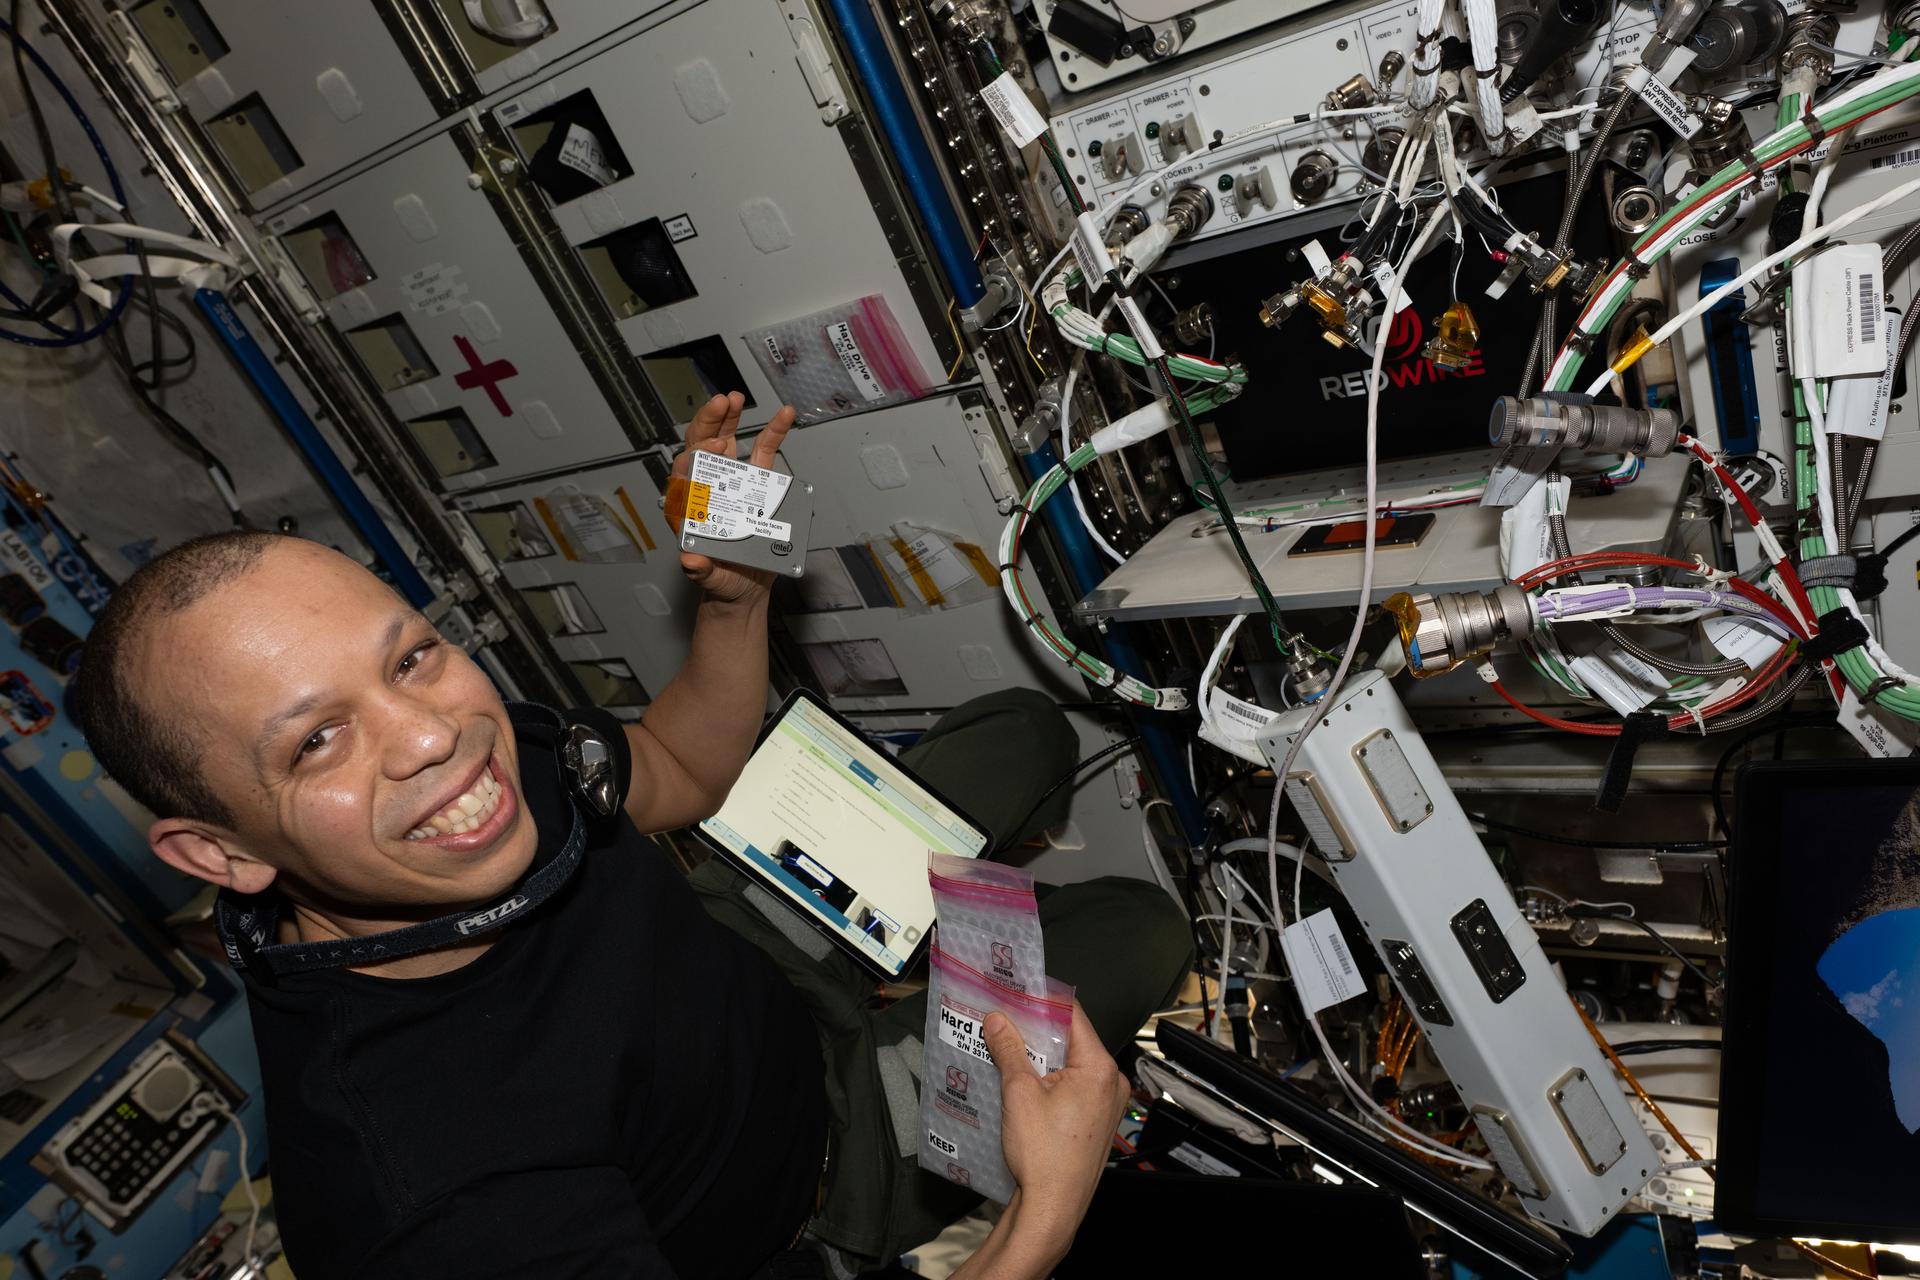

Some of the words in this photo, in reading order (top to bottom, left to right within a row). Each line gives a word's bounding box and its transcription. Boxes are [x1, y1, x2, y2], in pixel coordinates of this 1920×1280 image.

[1375, 29, 1392, 40] VIDEO
[1142, 91, 1170, 106] DRAWER
[1172, 87, 1179, 95] 2
[1166, 99, 1185, 110] POWER
[1651, 84, 1677, 109] EXPRESS
[1673, 104, 1690, 121] RACK
[1085, 111, 1110, 125] DRAWER
[1640, 85, 1656, 101] LANT
[1652, 97, 1673, 118] WATER
[1669, 113, 1691, 135] RETURN
[1107, 119, 1125, 129] POWER
[1862, 129, 1909, 146] Platform
[1197, 162, 1204, 170] 3
[1763, 179, 1776, 187] S/N
[1678, 231, 1717, 246] CLOSE
[765, 337, 782, 362] KEEP
[835, 322, 856, 352] Hard
[851, 351, 872, 382] Drive
[1884, 350, 1895, 380] SUPPLY
[1881, 381, 1889, 397] MTL
[1871, 384, 1882, 416] Multi-use
[1868, 416, 1876, 427] To
[709, 455, 719, 463] SSD
[734, 463, 748, 471] SERIES
[744, 517, 757, 525] This
[756, 519, 769, 527] side
[768, 521, 783, 530] faces
[754, 526, 772, 536] facility
[1727, 633, 1743, 647] Hose
[1867, 724, 1876, 733] To
[1863, 729, 1884, 752] COUPLER
[456, 897, 529, 934] PETZL
[295, 941, 387, 963] TIKKA
[941, 1007, 975, 1034] Hard
[950, 1029, 966, 1041] P/N
[955, 1040, 970, 1052] S/N
[929, 1131, 957, 1155] KEEP
